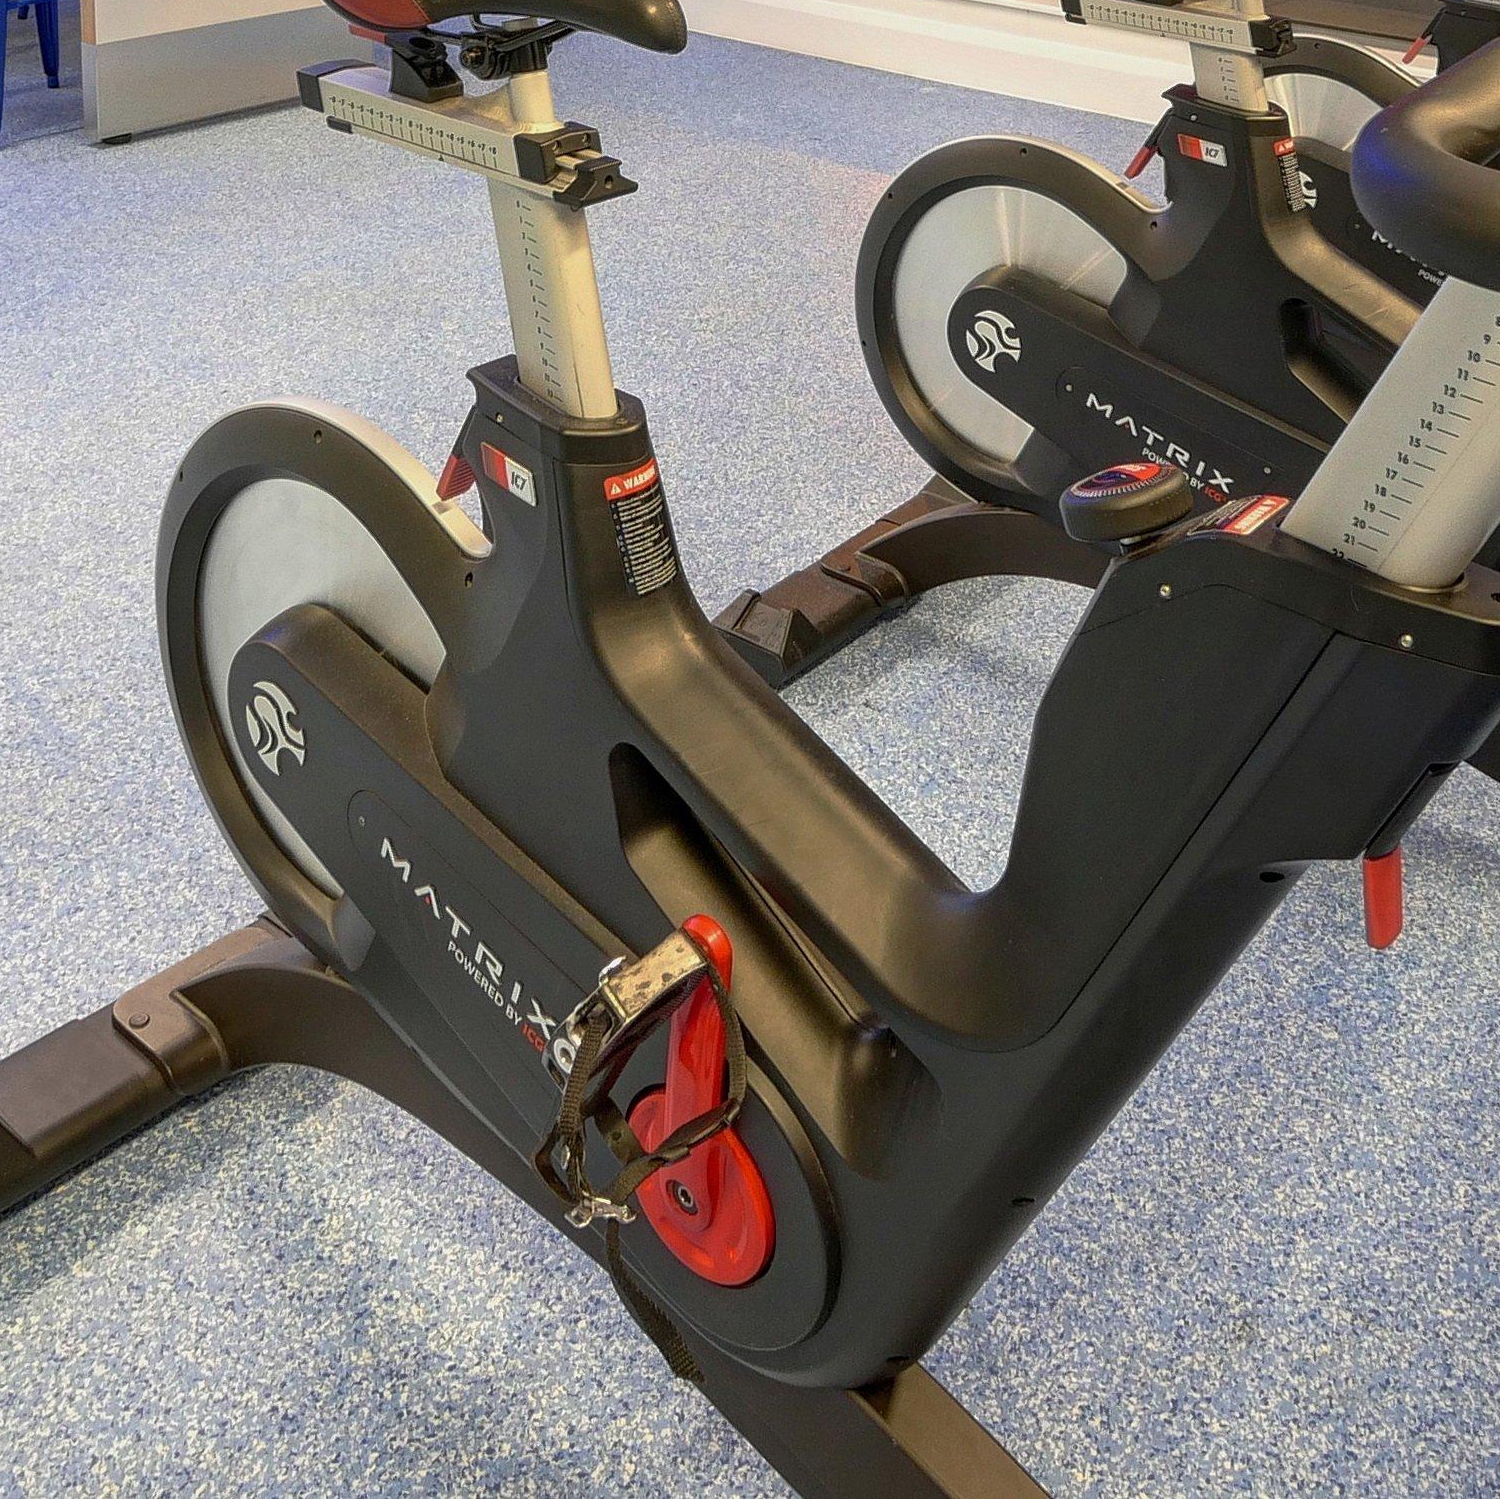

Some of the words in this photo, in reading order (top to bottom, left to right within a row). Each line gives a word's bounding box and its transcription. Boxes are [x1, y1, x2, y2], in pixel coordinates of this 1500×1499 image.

[1418, 268, 1445, 287] POWE
[1483, 333, 1492, 344] 9
[1467, 350, 1480, 363] 10
[1457, 367, 1469, 381] 11
[1443, 384, 1457, 398] 12
[1431, 401, 1444, 415] 13
[1419, 418, 1433, 432] 14
[1085, 393, 1235, 494] MATRIX
[1408, 435, 1421, 448] 15
[1397, 451, 1409, 465] 16
[1385, 467, 1398, 481] 17
[1189, 479, 1205, 491] BY
[1374, 484, 1387, 497] 18
[1363, 500, 1376, 513] 19
[1352, 517, 1366, 529] 20
[1343, 533, 1356, 546] 21
[381, 837, 557, 1040] MATRIX
[448, 941, 505, 1007] POWERED
[505, 1004, 523, 1026] BY
